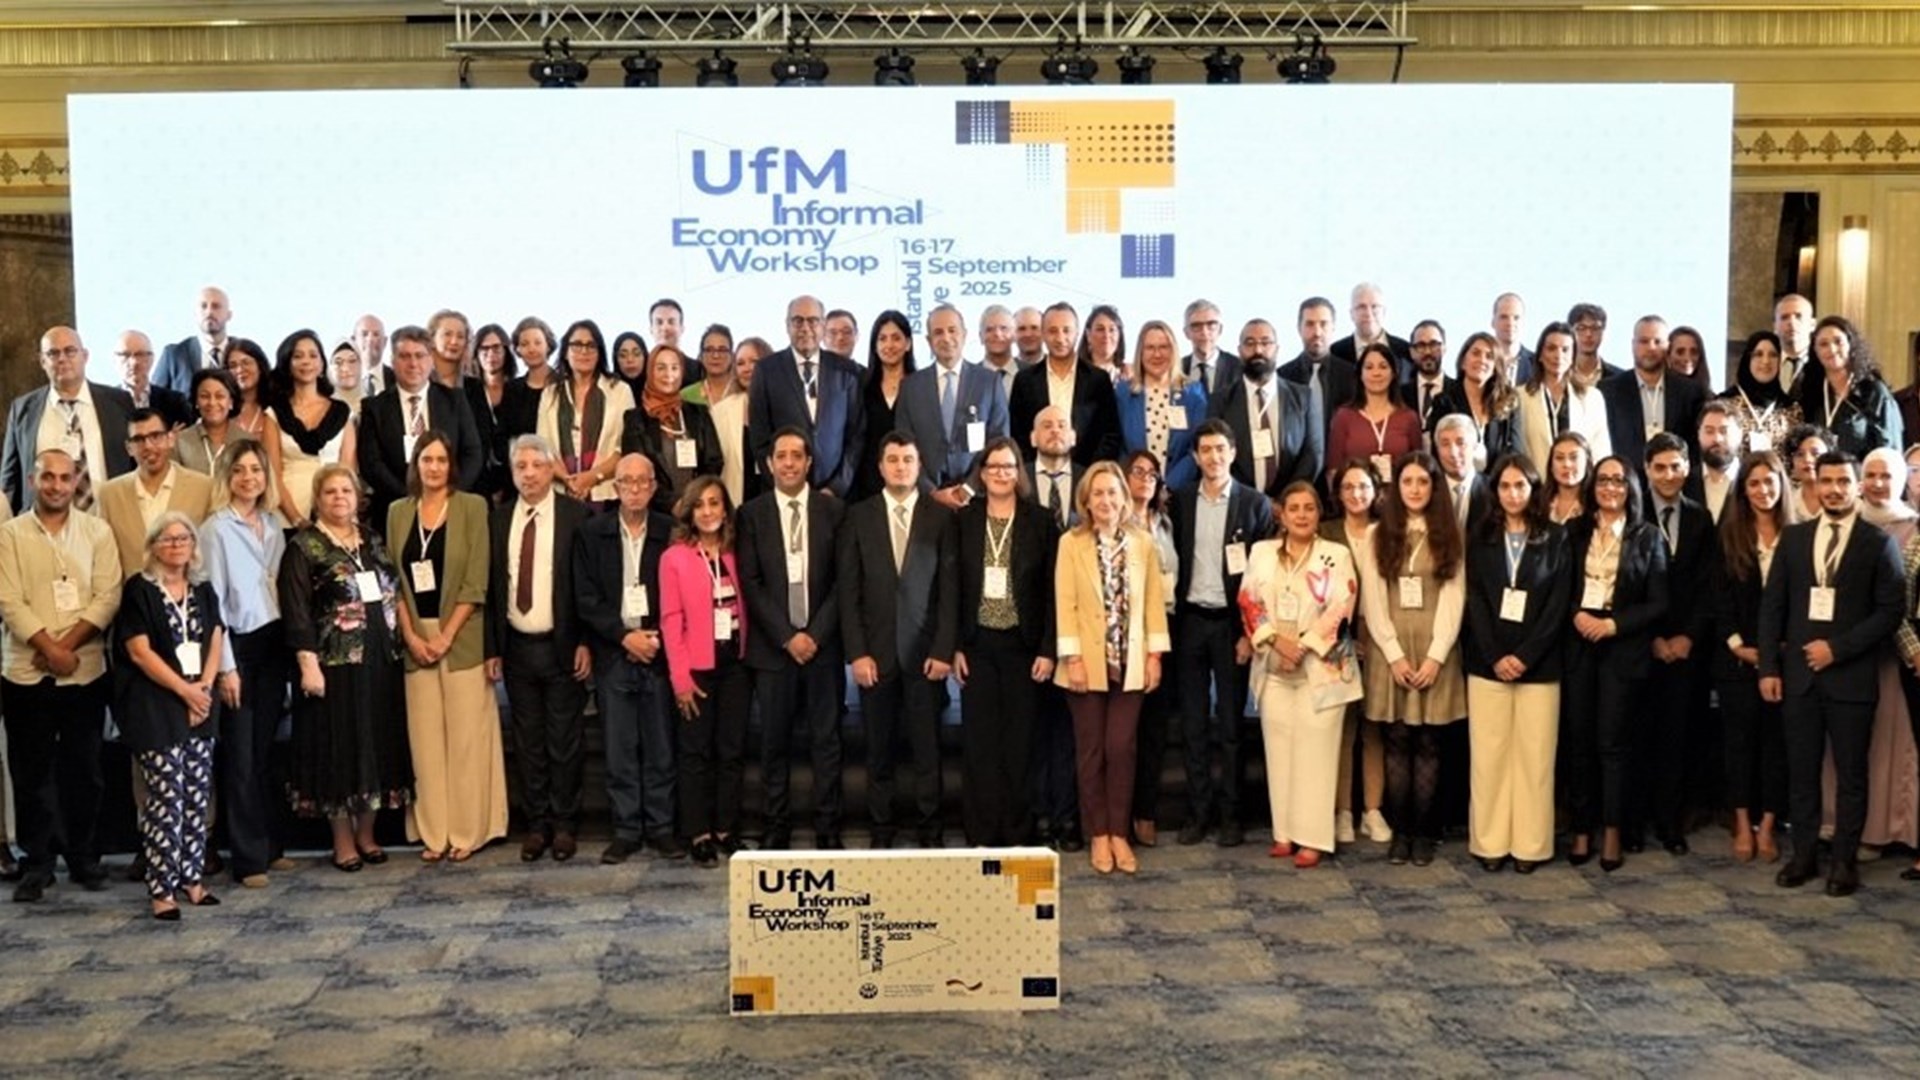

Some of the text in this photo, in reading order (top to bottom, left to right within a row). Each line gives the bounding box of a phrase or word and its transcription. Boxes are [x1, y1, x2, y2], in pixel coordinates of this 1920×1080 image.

[692, 147, 847, 195] UfM
[772, 194, 922, 226] Informal
[672, 217, 836, 251] Economy
[707, 248, 879, 275] Workshop
[928, 256, 1067, 278] September
[960, 280, 1012, 296] 2025
[759, 868, 834, 893] UfM
[798, 891, 871, 908] Informal
[749, 903, 829, 921] Economy
[766, 917, 850, 932] Workshop
[871, 920, 938, 931] September
[887, 932, 912, 941] 2025
